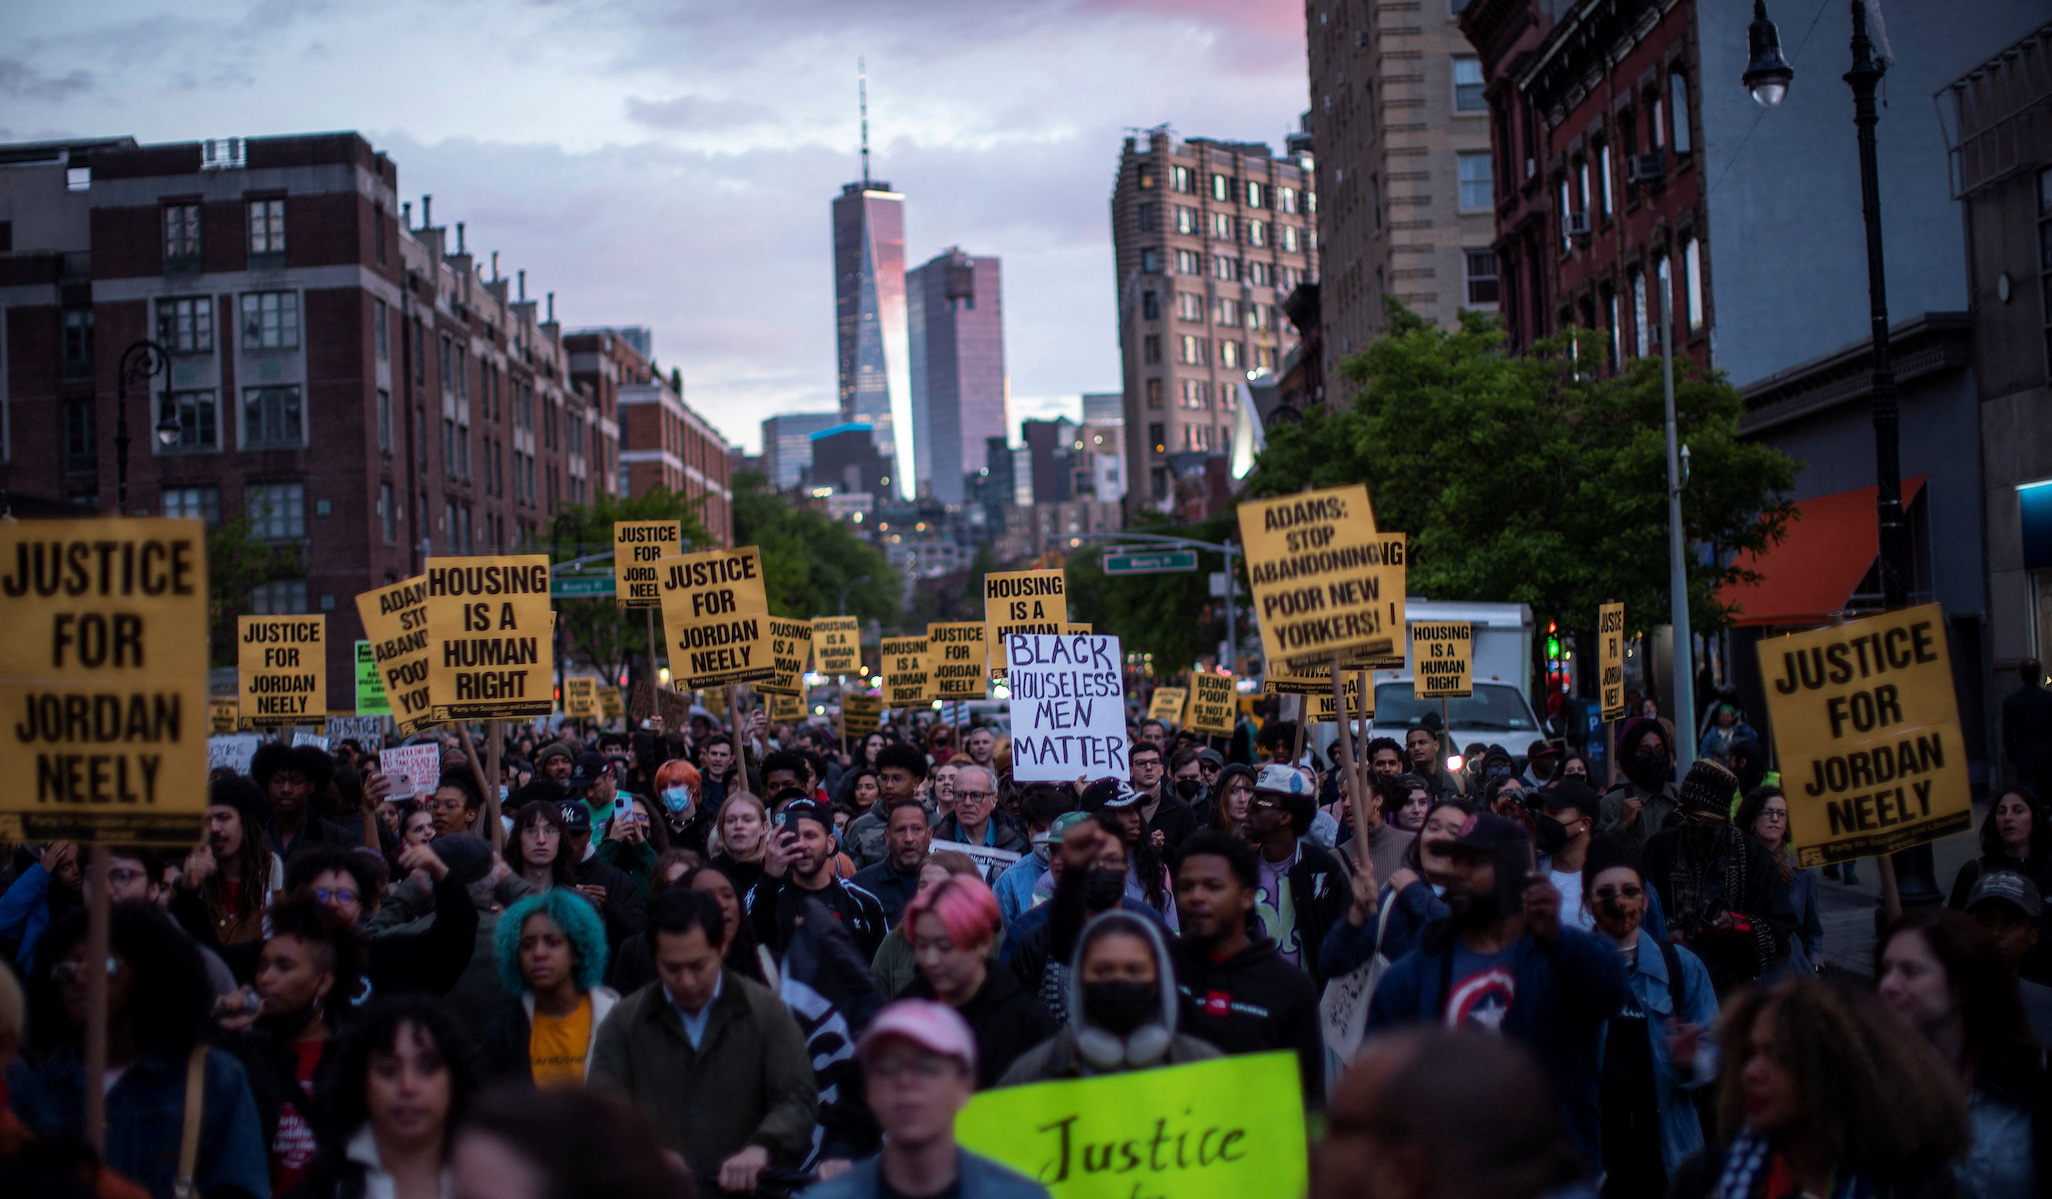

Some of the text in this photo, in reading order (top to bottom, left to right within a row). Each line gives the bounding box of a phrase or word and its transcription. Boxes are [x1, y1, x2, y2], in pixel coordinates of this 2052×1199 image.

[1265, 498, 1348, 533] ADAMS:
[618, 526, 676, 543] JUSTICE
[1286, 525, 1334, 552] STOP
[634, 546, 660, 561] FOR
[3, 540, 194, 597] JUSTICE
[624, 568, 658, 580] JORD
[664, 556, 756, 590] JUSTICE
[1253, 543, 1380, 586] ABANDONING
[429, 565, 547, 596] HOUSING
[988, 576, 1062, 598] HOUSING
[379, 581, 426, 615] ADAM
[630, 584, 660, 597] NEEL
[1263, 576, 1379, 620] POOR NEW
[692, 590, 736, 617] FOR
[1010, 600, 1044, 620] IS A
[464, 602, 517, 631] IS A
[244, 623, 320, 642] JUSTICE
[680, 620, 758, 650] JORDAN
[770, 622, 812, 640] OUSING
[814, 622, 857, 632] HOUSING
[931, 627, 983, 642] JUSTICE
[1274, 610, 1381, 651] YORKERS!
[1414, 626, 1469, 640] HOUSING
[53, 612, 144, 668] FOR
[774, 640, 794, 655] IS A
[827, 634, 846, 644] IS A
[265, 648, 299, 667] FOR
[444, 637, 537, 667] HUMAN
[690, 645, 751, 674] NEELY
[820, 648, 854, 658] HUMAN
[946, 646, 970, 659] FOR
[1010, 635, 1112, 670] BLACK
[1431, 644, 1455, 657] IS A
[1775, 622, 1937, 694] JUSTICE
[775, 658, 800, 672] MAN
[825, 659, 852, 670] RIGHT
[896, 658, 919, 670] IS A
[934, 665, 980, 678] JORDAN
[1422, 661, 1464, 674] HUMAN
[249, 675, 315, 693] JORDAN
[456, 670, 528, 700] RIGHT
[888, 672, 927, 686] HUMAN
[940, 680, 974, 692] NEELY
[1010, 671, 1120, 700] HOUSELESS
[1198, 676, 1230, 690] BEING
[1427, 676, 1460, 690] RIGHT
[894, 687, 922, 700] RIGHT
[1198, 690, 1228, 704] POOR
[258, 696, 308, 714] NEELY
[1034, 698, 1092, 730] MEN
[1194, 704, 1232, 717] IS NOT A
[1828, 684, 1903, 738] FOR
[15, 693, 181, 743] JORDAN
[1197, 715, 1225, 727] CRIME
[1014, 736, 1124, 771] MATTER
[1806, 732, 1946, 797] JORDAN
[37, 753, 161, 803] NEELY
[1827, 780, 1932, 836] NEELY
[1038, 1108, 1247, 1185] Justice
